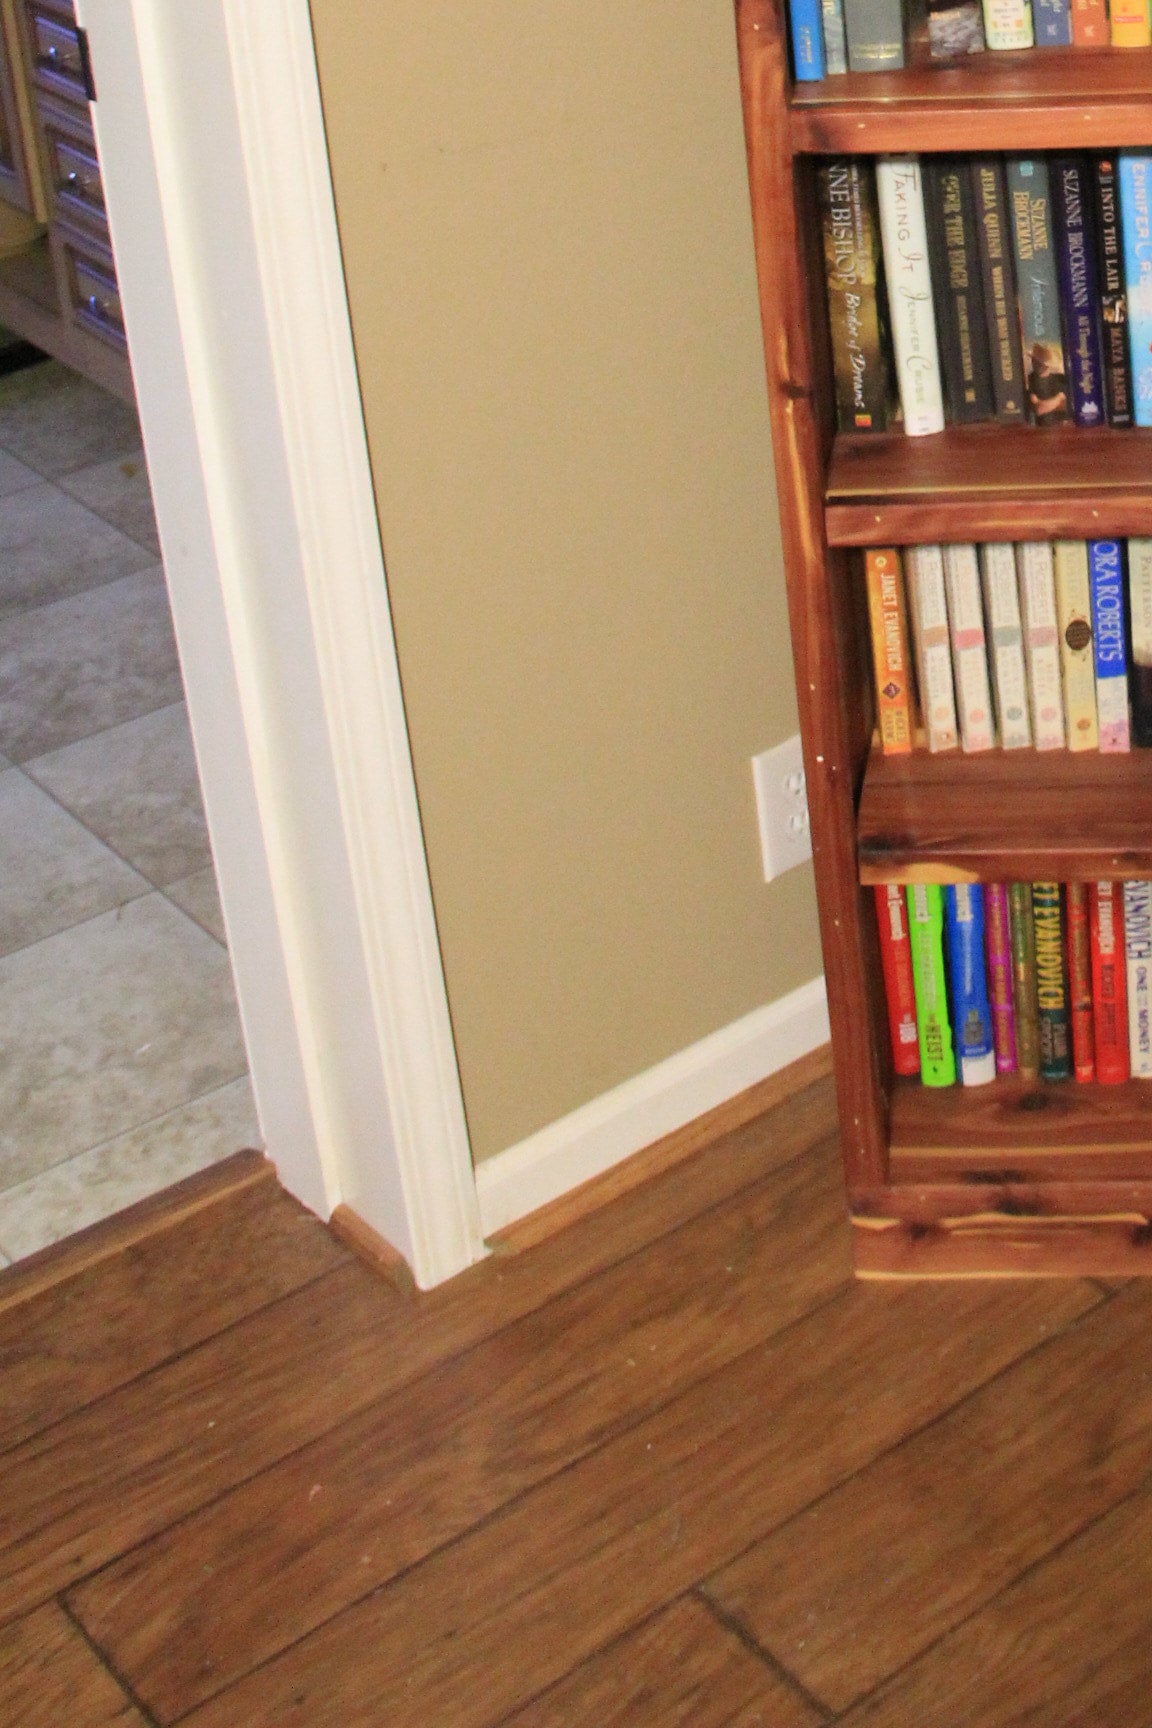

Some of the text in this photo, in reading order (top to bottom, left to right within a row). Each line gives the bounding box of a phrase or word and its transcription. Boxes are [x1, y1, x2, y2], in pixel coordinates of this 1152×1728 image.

[1013, 191, 1033, 260] BROCKMANN
[1031, 197, 1048, 250] SUZANNE
[1062, 169, 1084, 227] SUZANNE
[829, 207, 857, 286] BISHOP
[1101, 187, 1120, 291] INTO THE LAIR
[881, 571, 903, 672] JANET EVANOVICH
[1098, 585, 1123, 662] ROBERTS
[1033, 906, 1065, 1010] EVANOVICH
